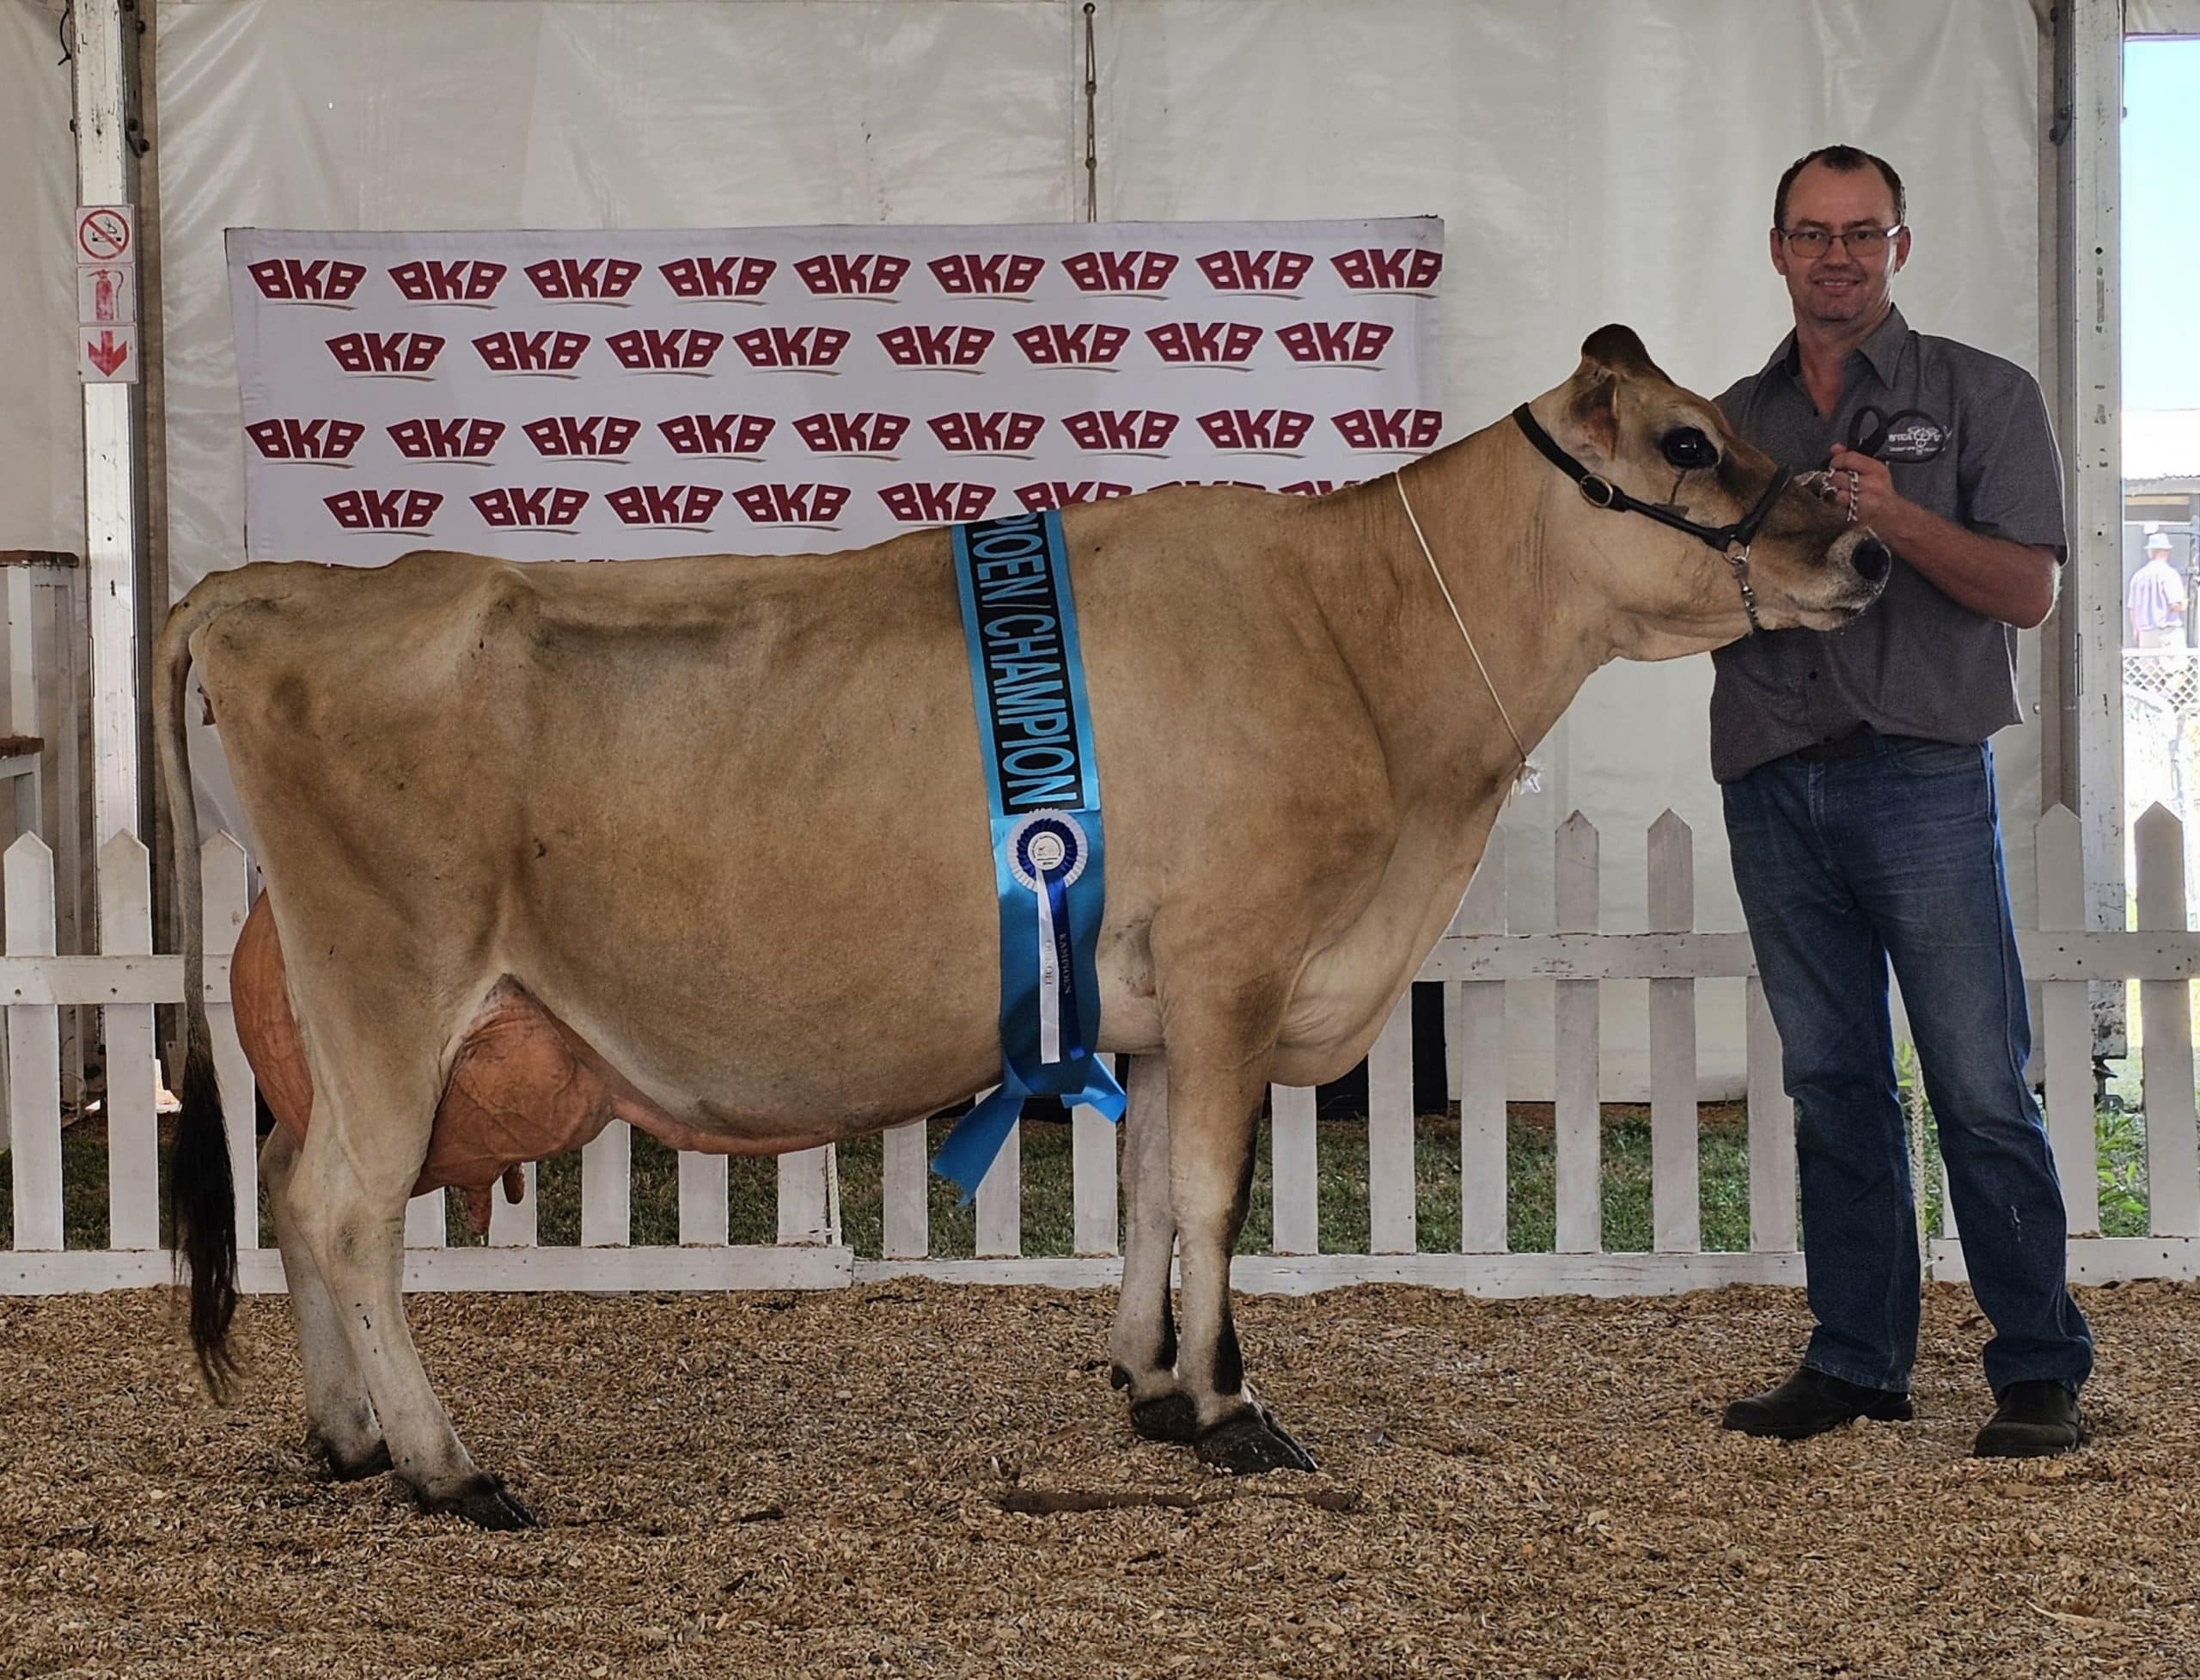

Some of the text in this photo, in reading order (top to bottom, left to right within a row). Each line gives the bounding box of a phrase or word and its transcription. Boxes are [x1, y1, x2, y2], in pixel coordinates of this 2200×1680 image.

[248, 249, 1441, 300] BKB BKB BKB BKB BKB BKB BKB BKB BKB
[326, 321, 1393, 371] BKB BKB BKB BKB BKB BKB BKB BKB
[246, 408, 1441, 457] BKB BKB BKB BKB BKB BKB BKB BKB BKB
[323, 490, 443, 527] BKB
[469, 486, 589, 525] BKB
[604, 485, 723, 523] BKB
[733, 483, 850, 522] BKB
[877, 482, 997, 520] BKB
